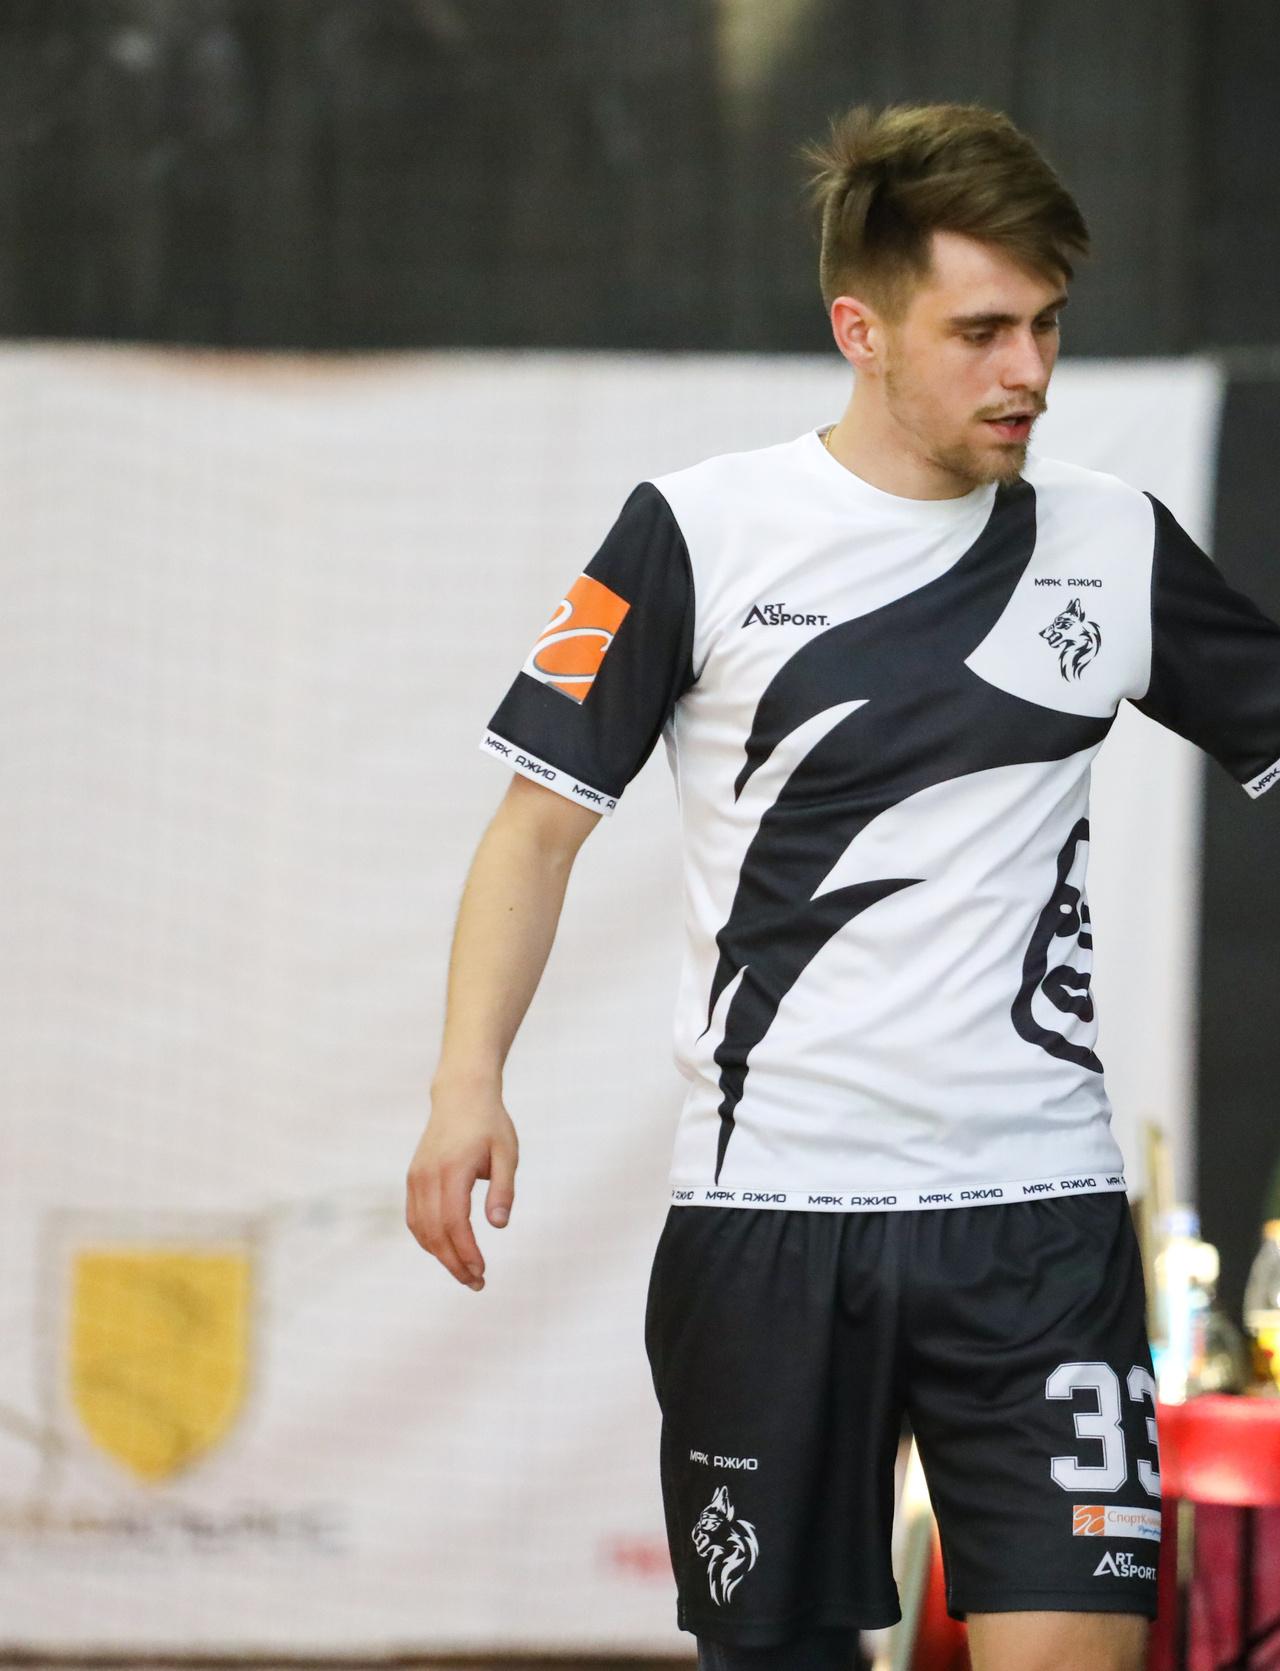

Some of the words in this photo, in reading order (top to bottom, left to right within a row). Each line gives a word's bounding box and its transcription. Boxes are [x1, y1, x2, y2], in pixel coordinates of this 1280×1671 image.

[1034, 578, 1062, 587] МФК
[1067, 578, 1103, 588] АЖИО
[741, 603, 786, 629] ART
[484, 736, 512, 758] МФК
[514, 755, 557, 782] АЖИО
[572, 784, 605, 805] МФК
[1252, 767, 1280, 792] МФК
[705, 1190, 736, 1201] МФК
[742, 1192, 787, 1203] АЖИО
[808, 1195, 843, 1205] МФК
[851, 1196, 897, 1205] АЖИО
[918, 1192, 953, 1204] МФК
[960, 1188, 1003, 1200] АЖИО
[1022, 1183, 1055, 1194] МФК
[1060, 1178, 1097, 1190] АЖИО
[1045, 1361, 1162, 1498] 33
[689, 1449, 709, 1466] МФК
[713, 1455, 758, 1470] АЖИО
[1092, 1550, 1134, 1577] ART
